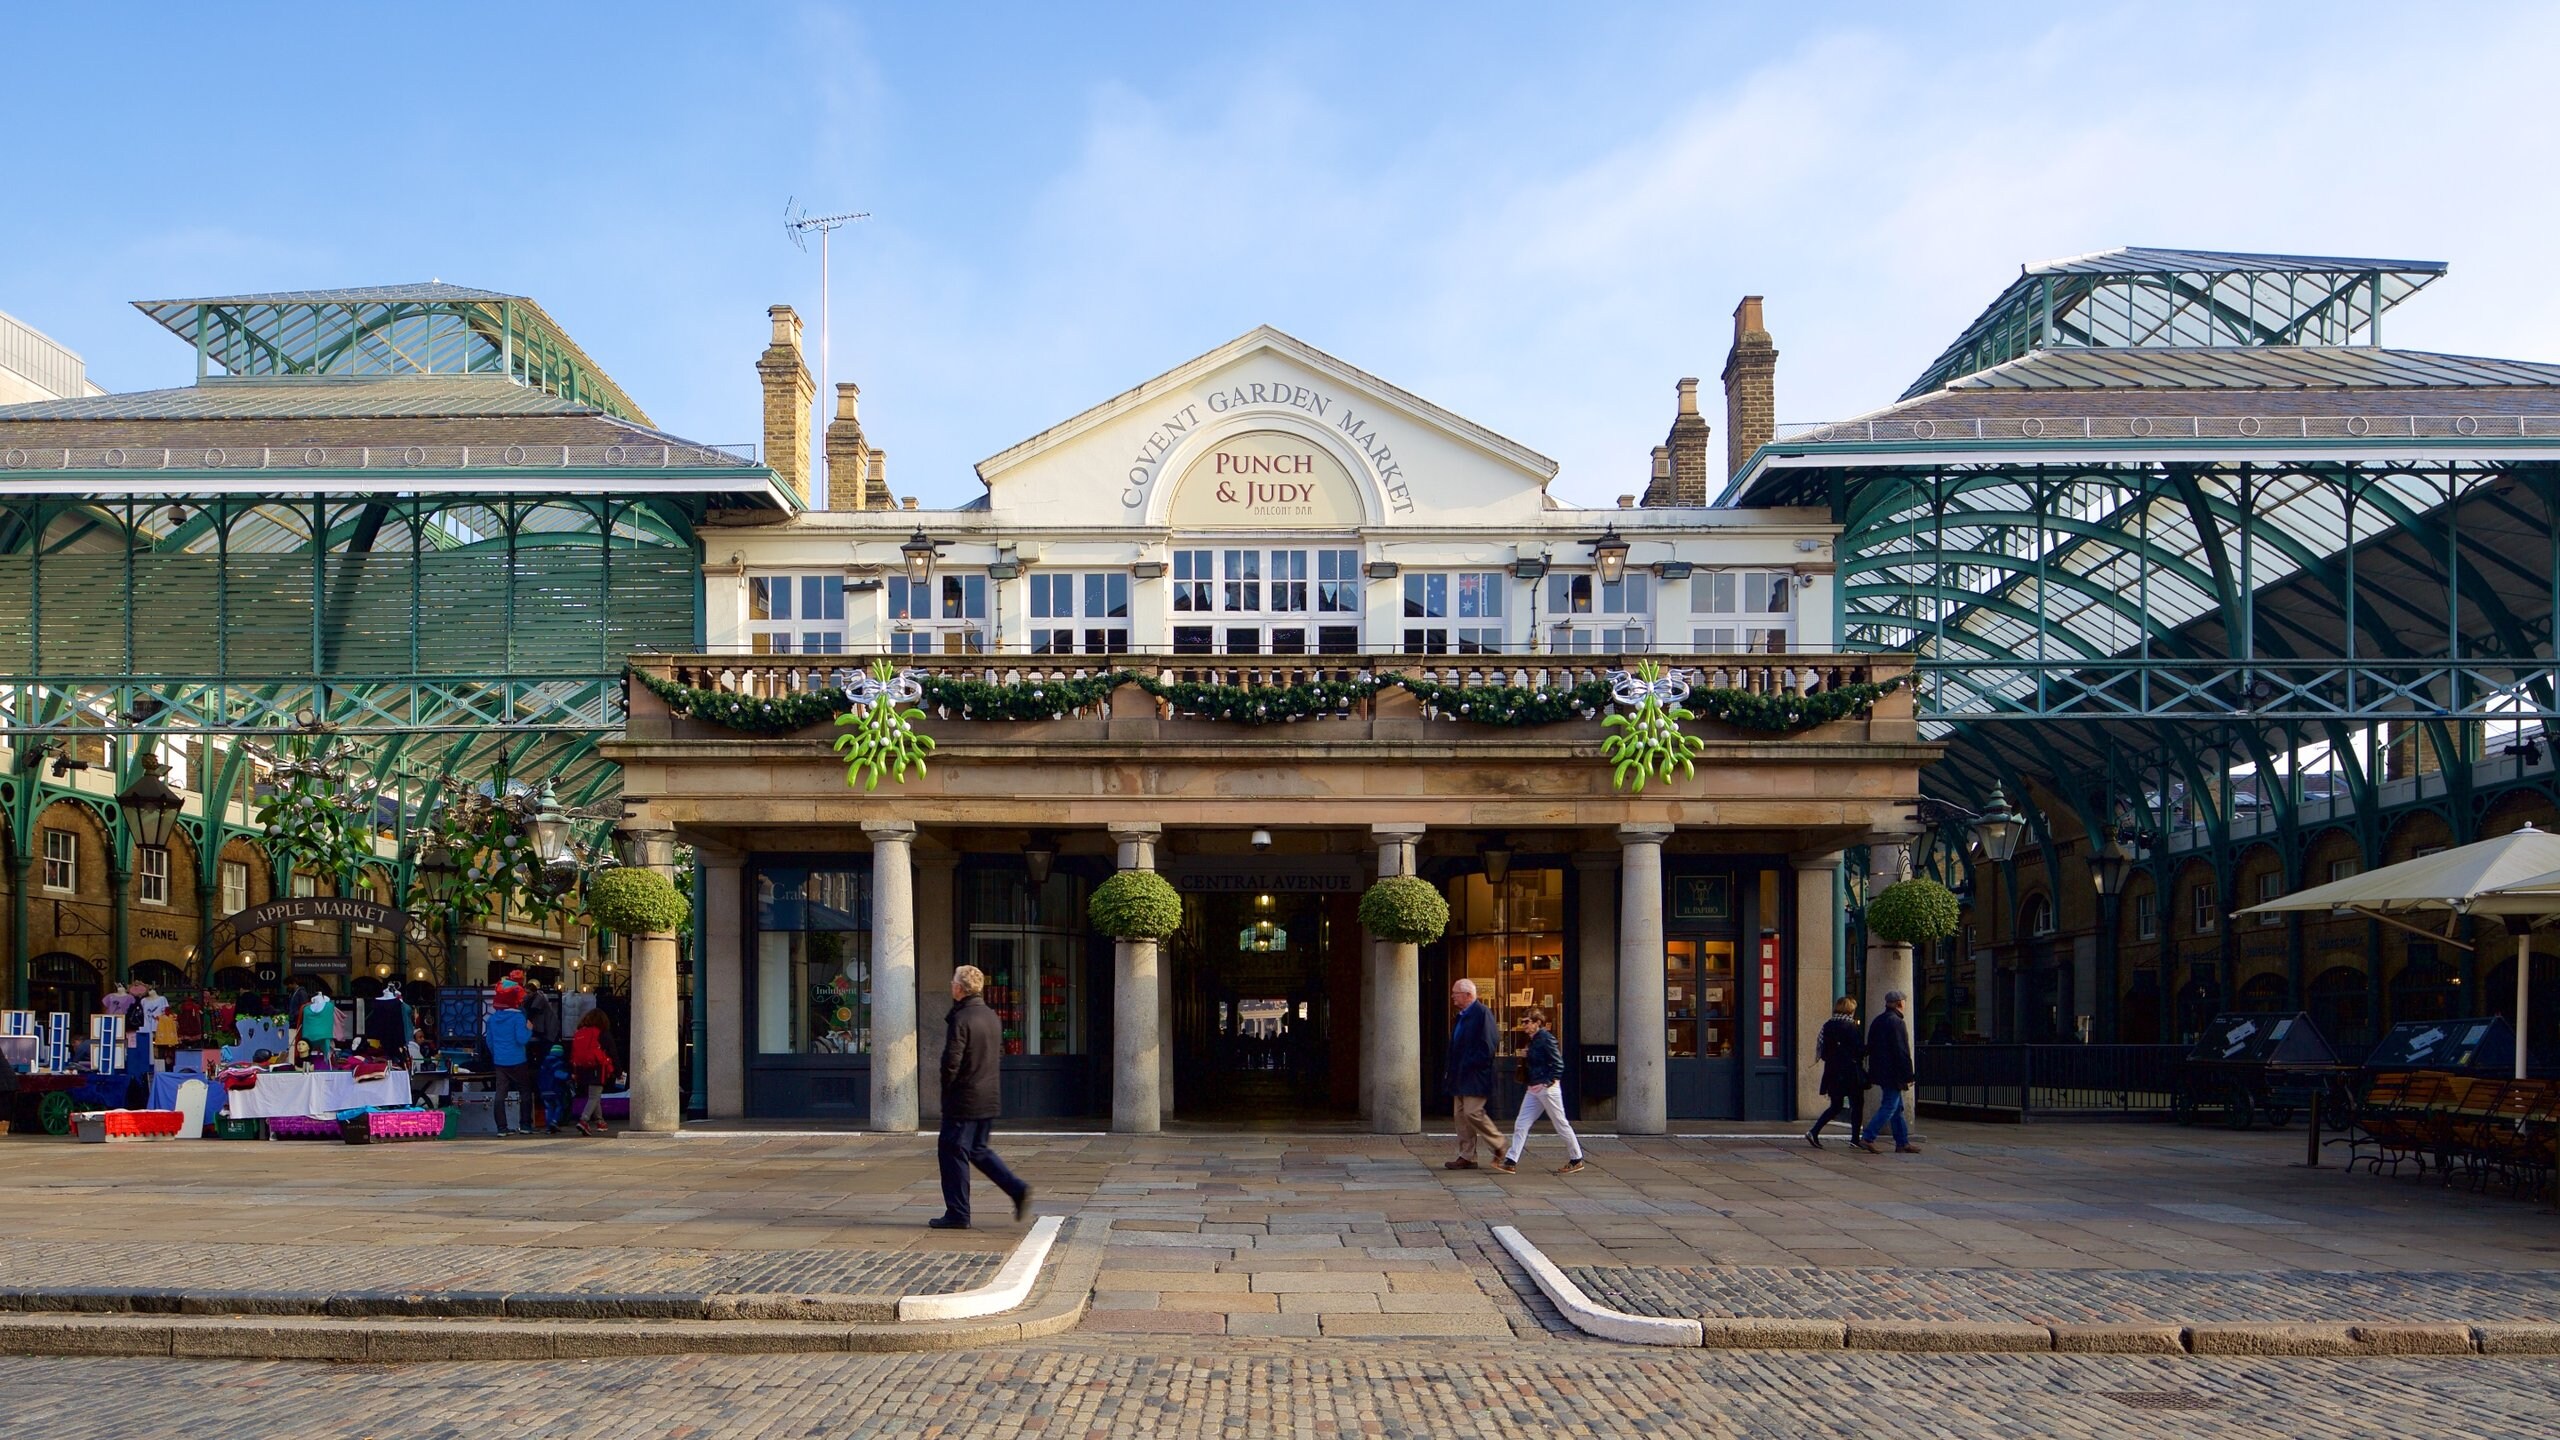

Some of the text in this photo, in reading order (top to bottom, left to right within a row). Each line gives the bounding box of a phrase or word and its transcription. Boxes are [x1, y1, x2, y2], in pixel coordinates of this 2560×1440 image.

[1121, 382, 1416, 515] COVENT GARDEN MARKET
[1215, 481, 1239, 504] &
[1295, 506, 1314, 516] BAR
[1180, 874, 1352, 890] CENTRAL AVENUE
[255, 901, 389, 925] APPLE MARKET
[140, 927, 179, 941] CHANEL
[816, 985, 857, 996] Indulgent
[1586, 1055, 1616, 1064] LITTER
